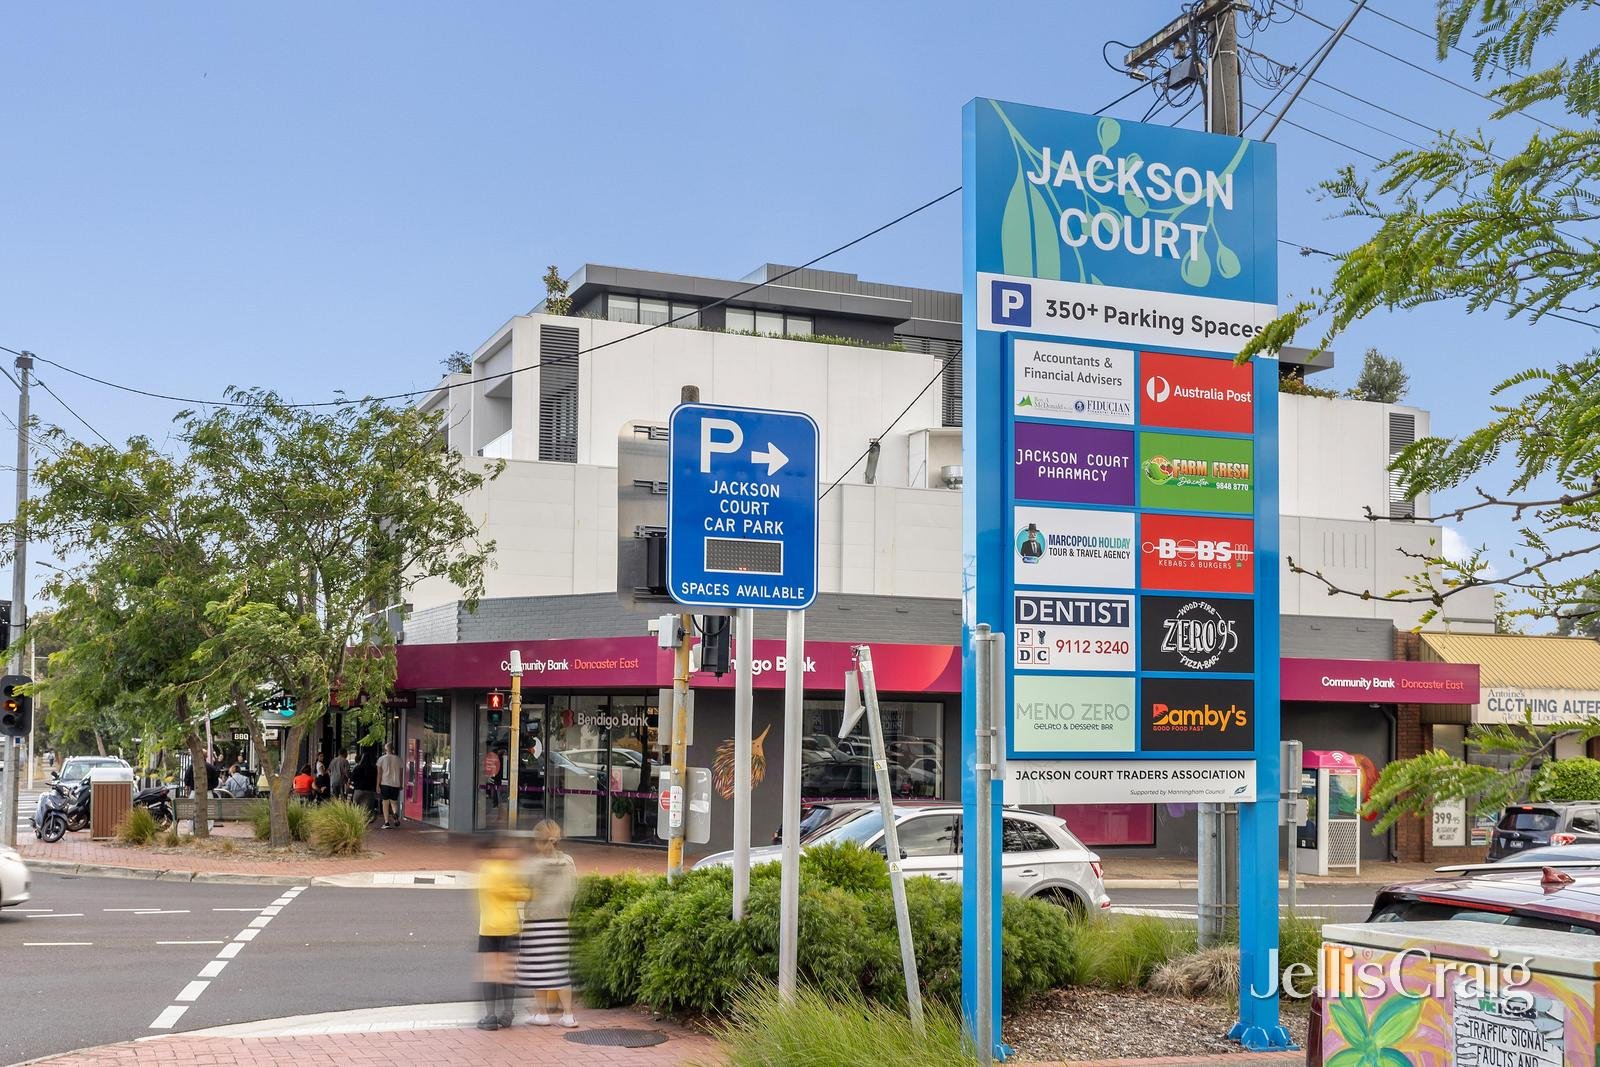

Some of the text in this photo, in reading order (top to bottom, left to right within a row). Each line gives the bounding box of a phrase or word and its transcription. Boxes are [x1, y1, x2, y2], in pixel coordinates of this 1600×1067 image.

[1026, 147, 1234, 210] JACKSON
[1059, 208, 1207, 261] COURT
[1002, 289, 1024, 317] P
[1045, 299, 1263, 339] 350+ Parking Spaces
[1033, 350, 1113, 368] Accountants &
[1024, 367, 1122, 387] Financial Advisers
[1174, 385, 1252, 403] Australia Post
[1087, 400, 1130, 413] FIDUCIAN
[700, 417, 744, 473] P
[1016, 448, 1129, 468] JACKSON COURT
[1038, 466, 1108, 482] PHARMACY
[1172, 459, 1249, 479] FARM FRESH
[709, 480, 780, 498] JACKSON
[719, 500, 770, 516] COURT
[704, 517, 784, 535] CAR PARK
[1048, 534, 1131, 549] MARCOPOLO HOLIDAY
[1049, 547, 1131, 560] TOUR & TRAVEL AGENCY
[1158, 560, 1188, 568] KEBABS
[1198, 561, 1232, 570] BURGERS
[681, 582, 805, 600] SPACES AVAILABLE
[1019, 599, 1127, 624] DENTIST
[1020, 631, 1030, 642] P
[1020, 650, 1047, 661] D C
[1056, 639, 1129, 655] 9112 3240
[500, 657, 638, 674] Comunity Bank Doncaster East
[1321, 676, 1464, 691] Community Bank Doncaster East
[1016, 703, 1130, 722] MENO ZERO
[1487, 698, 1557, 713] CLOTHING
[577, 713, 649, 730] Bendigo Bank
[1101, 723, 1114, 731] BAR
[1015, 769, 1246, 781] JACKSON COURT TRADERS ASSOCIATION
[1469, 1019, 1548, 1052] TRAFFIC SIGNAL
[1477, 1046, 1539, 1067] FAULTS AND
